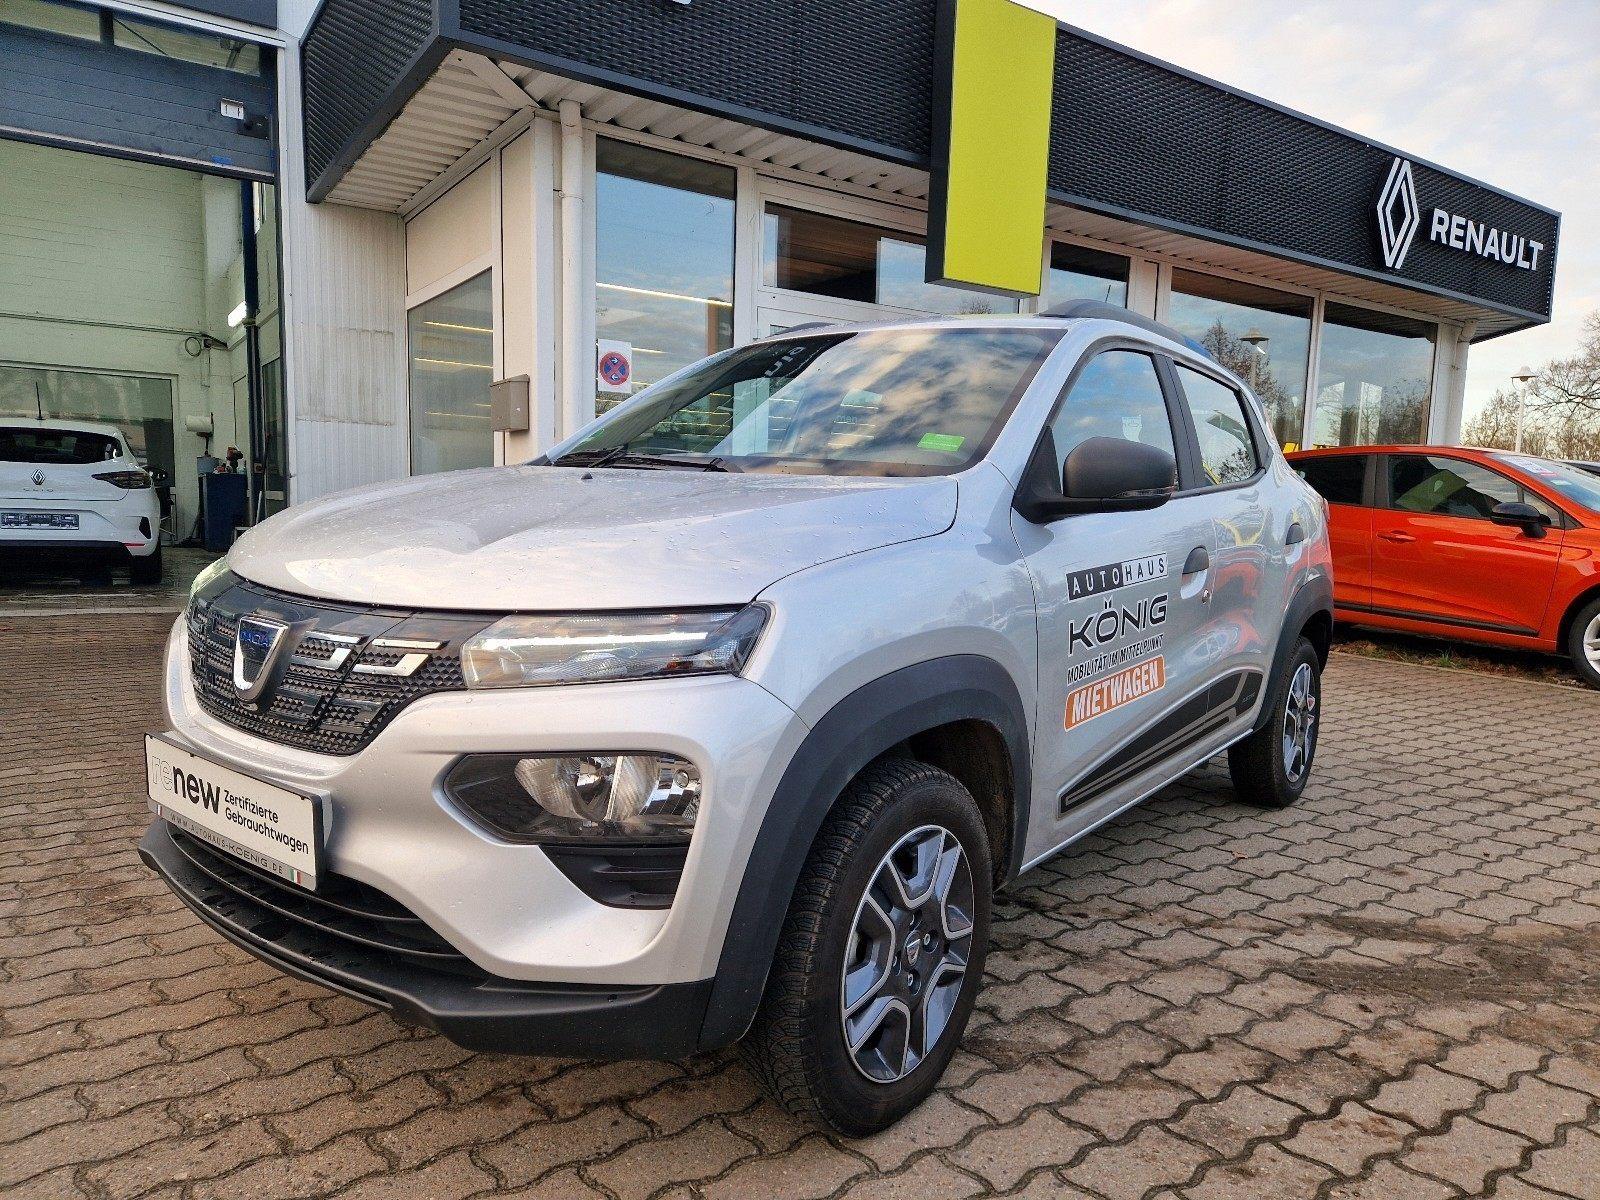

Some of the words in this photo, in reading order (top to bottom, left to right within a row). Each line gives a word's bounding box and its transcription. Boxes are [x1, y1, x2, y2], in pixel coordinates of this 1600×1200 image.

[1430, 208, 1544, 271] RENAULT
[1072, 557, 1166, 596] AUTOHAUS
[1068, 594, 1169, 657] KÖNIG
[1067, 652, 1107, 687] MOBILITÄT
[1108, 650, 1119, 668] IM
[1119, 633, 1164, 665] MITTELPUNKT
[1071, 660, 1159, 724] MIETWAGEN
[224, 789, 279, 824] Zertifizierte
[225, 807, 309, 854] Gebrauchtwagen
